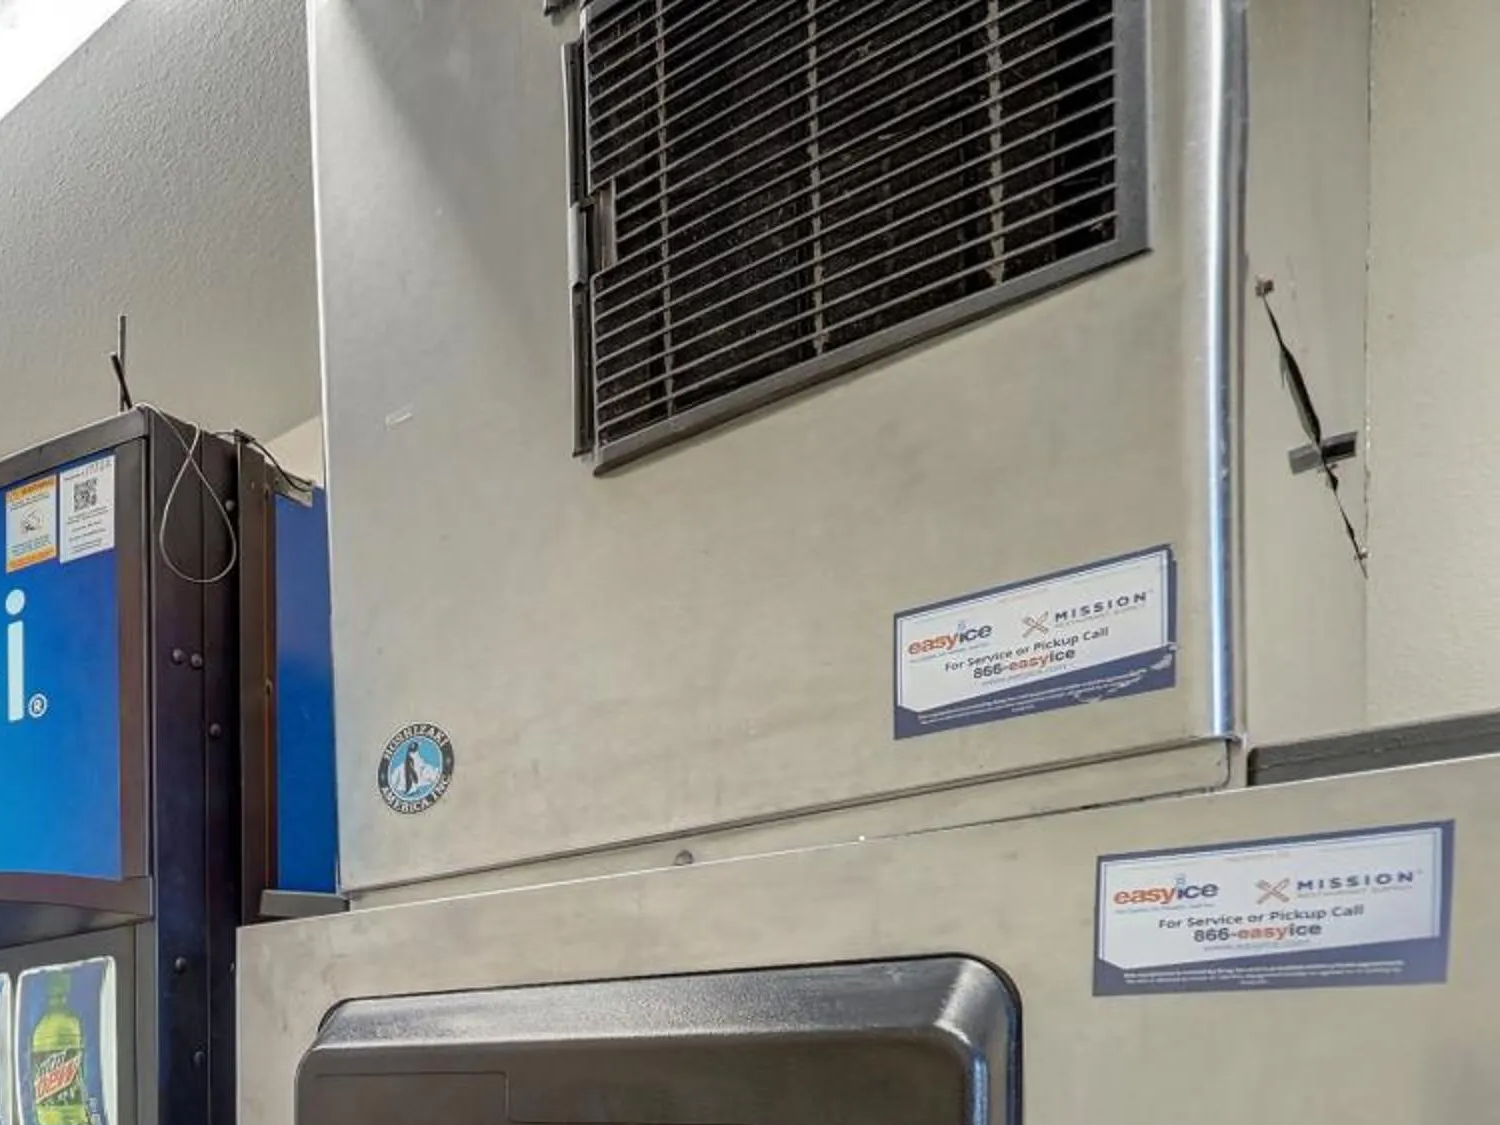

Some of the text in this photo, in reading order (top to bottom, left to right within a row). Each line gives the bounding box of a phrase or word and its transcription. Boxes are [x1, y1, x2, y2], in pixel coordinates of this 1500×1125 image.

[1054, 591, 1147, 622] MISSION
[944, 659, 966, 672] For
[968, 650, 1013, 668] Service
[1016, 645, 1032, 657] or
[1033, 633, 1080, 655] Pickup
[1082, 626, 1110, 642] Call
[972, 648, 1076, 679] 866-easyice
[1112, 871, 1416, 906] easyice MISSION
[1158, 905, 1364, 930] For Service or Pickup Call
[1193, 922, 1323, 943] 866-easyice
